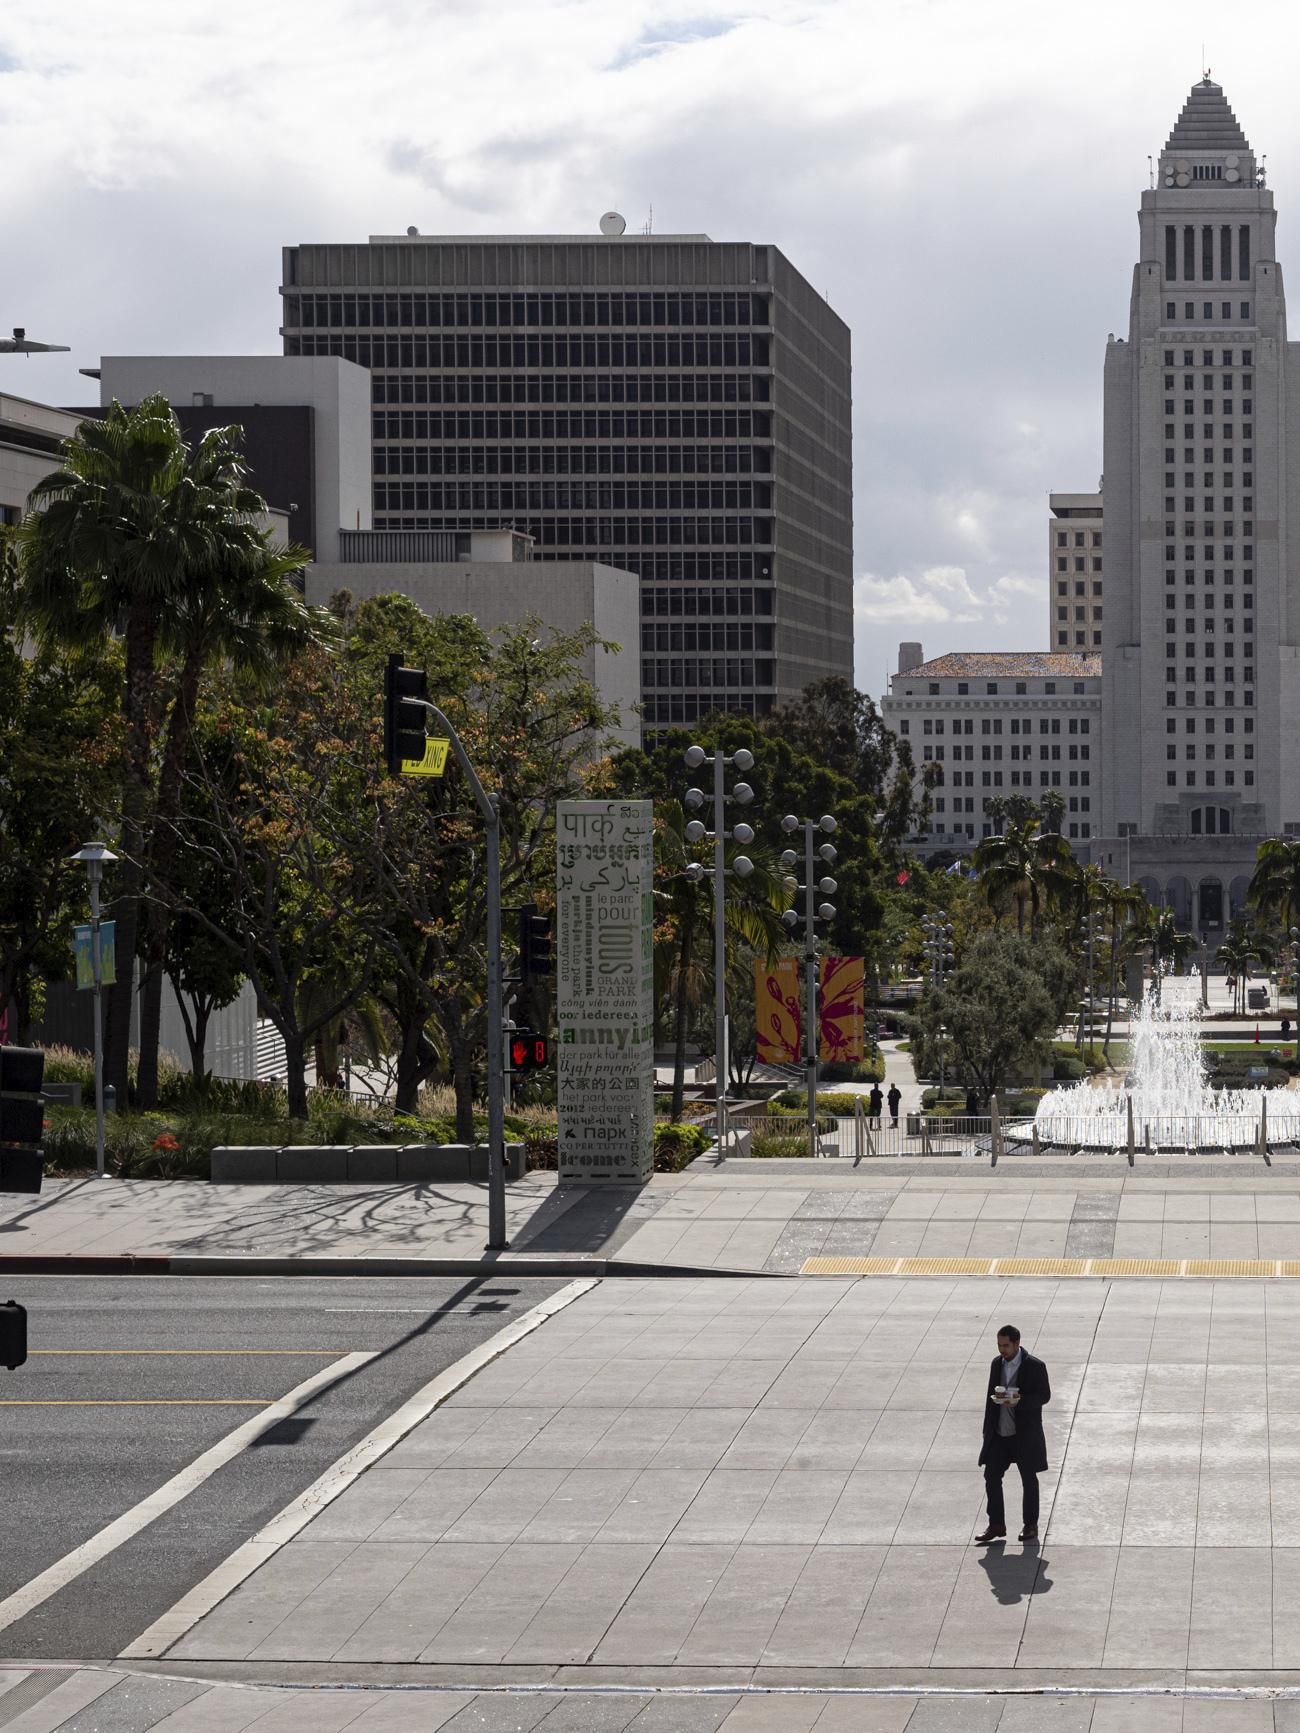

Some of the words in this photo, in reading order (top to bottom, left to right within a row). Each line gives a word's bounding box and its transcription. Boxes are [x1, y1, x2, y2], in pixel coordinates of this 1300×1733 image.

[424, 745, 444, 768] XING
[598, 893, 607, 903] le
[610, 895, 634, 905] parc
[561, 900, 570, 916] for
[598, 906, 640, 924] pour
[559, 923, 570, 982] everyone
[573, 944, 582, 964] the
[599, 924, 639, 974] tous
[572, 967, 582, 998] park
[598, 976, 637, 985] GRAND
[598, 986, 636, 996] PARK
[559, 1047, 577, 1060] der
[579, 1047, 602, 1063] park
[561, 1077, 640, 1090] 大家的公園
[562, 1091, 579, 1103] het
[582, 1091, 607, 1104] park
[560, 1104, 585, 1112] 2012
